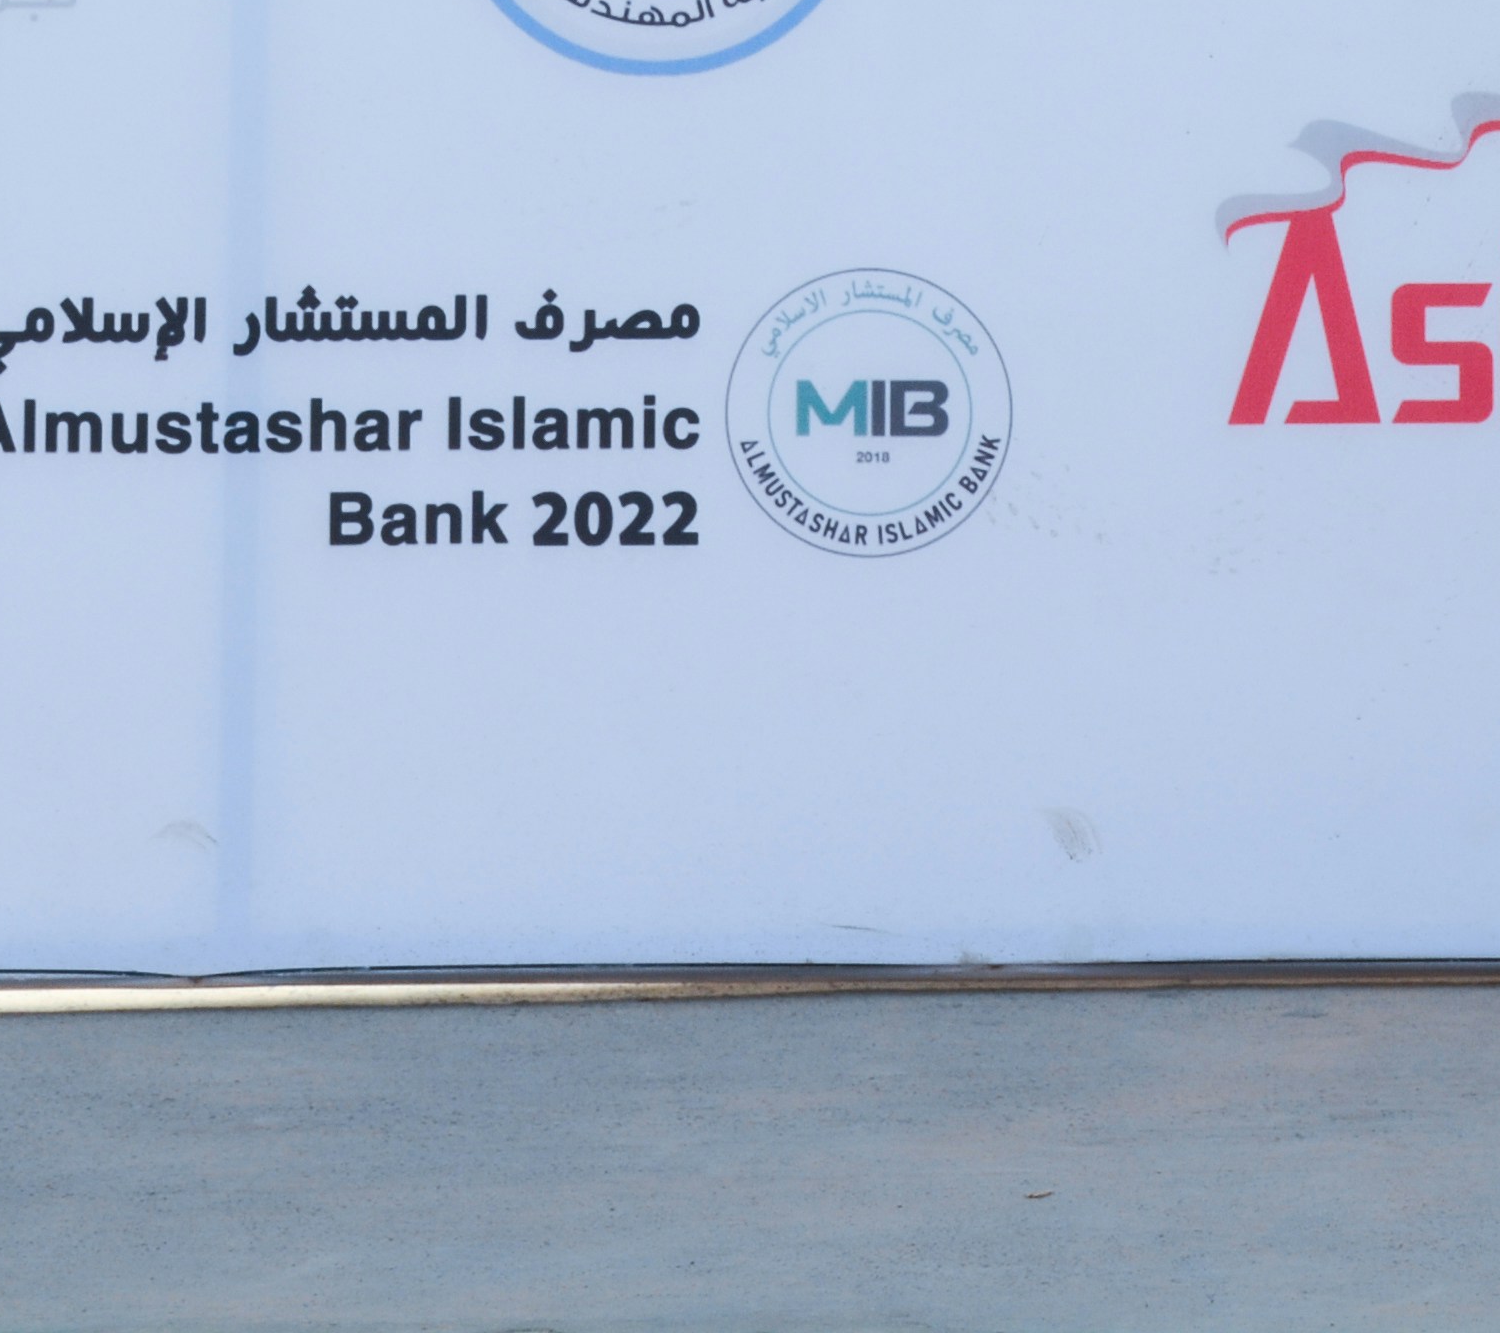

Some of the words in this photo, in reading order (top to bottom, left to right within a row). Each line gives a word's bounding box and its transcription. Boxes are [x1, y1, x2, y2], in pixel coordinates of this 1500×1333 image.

[233, 285, 487, 350] المستشار
[515, 289, 700, 347] مصرف
[448, 395, 699, 451] Islamic
[796, 379, 949, 437] MIB
[856, 451, 890, 463] 2018
[329, 490, 508, 546] Bank
[532, 491, 698, 546] 2022
[740, 438, 868, 546] ALMUSTASHAR
[877, 492, 963, 545] ISLAMIC
[958, 433, 1001, 494] BANK
